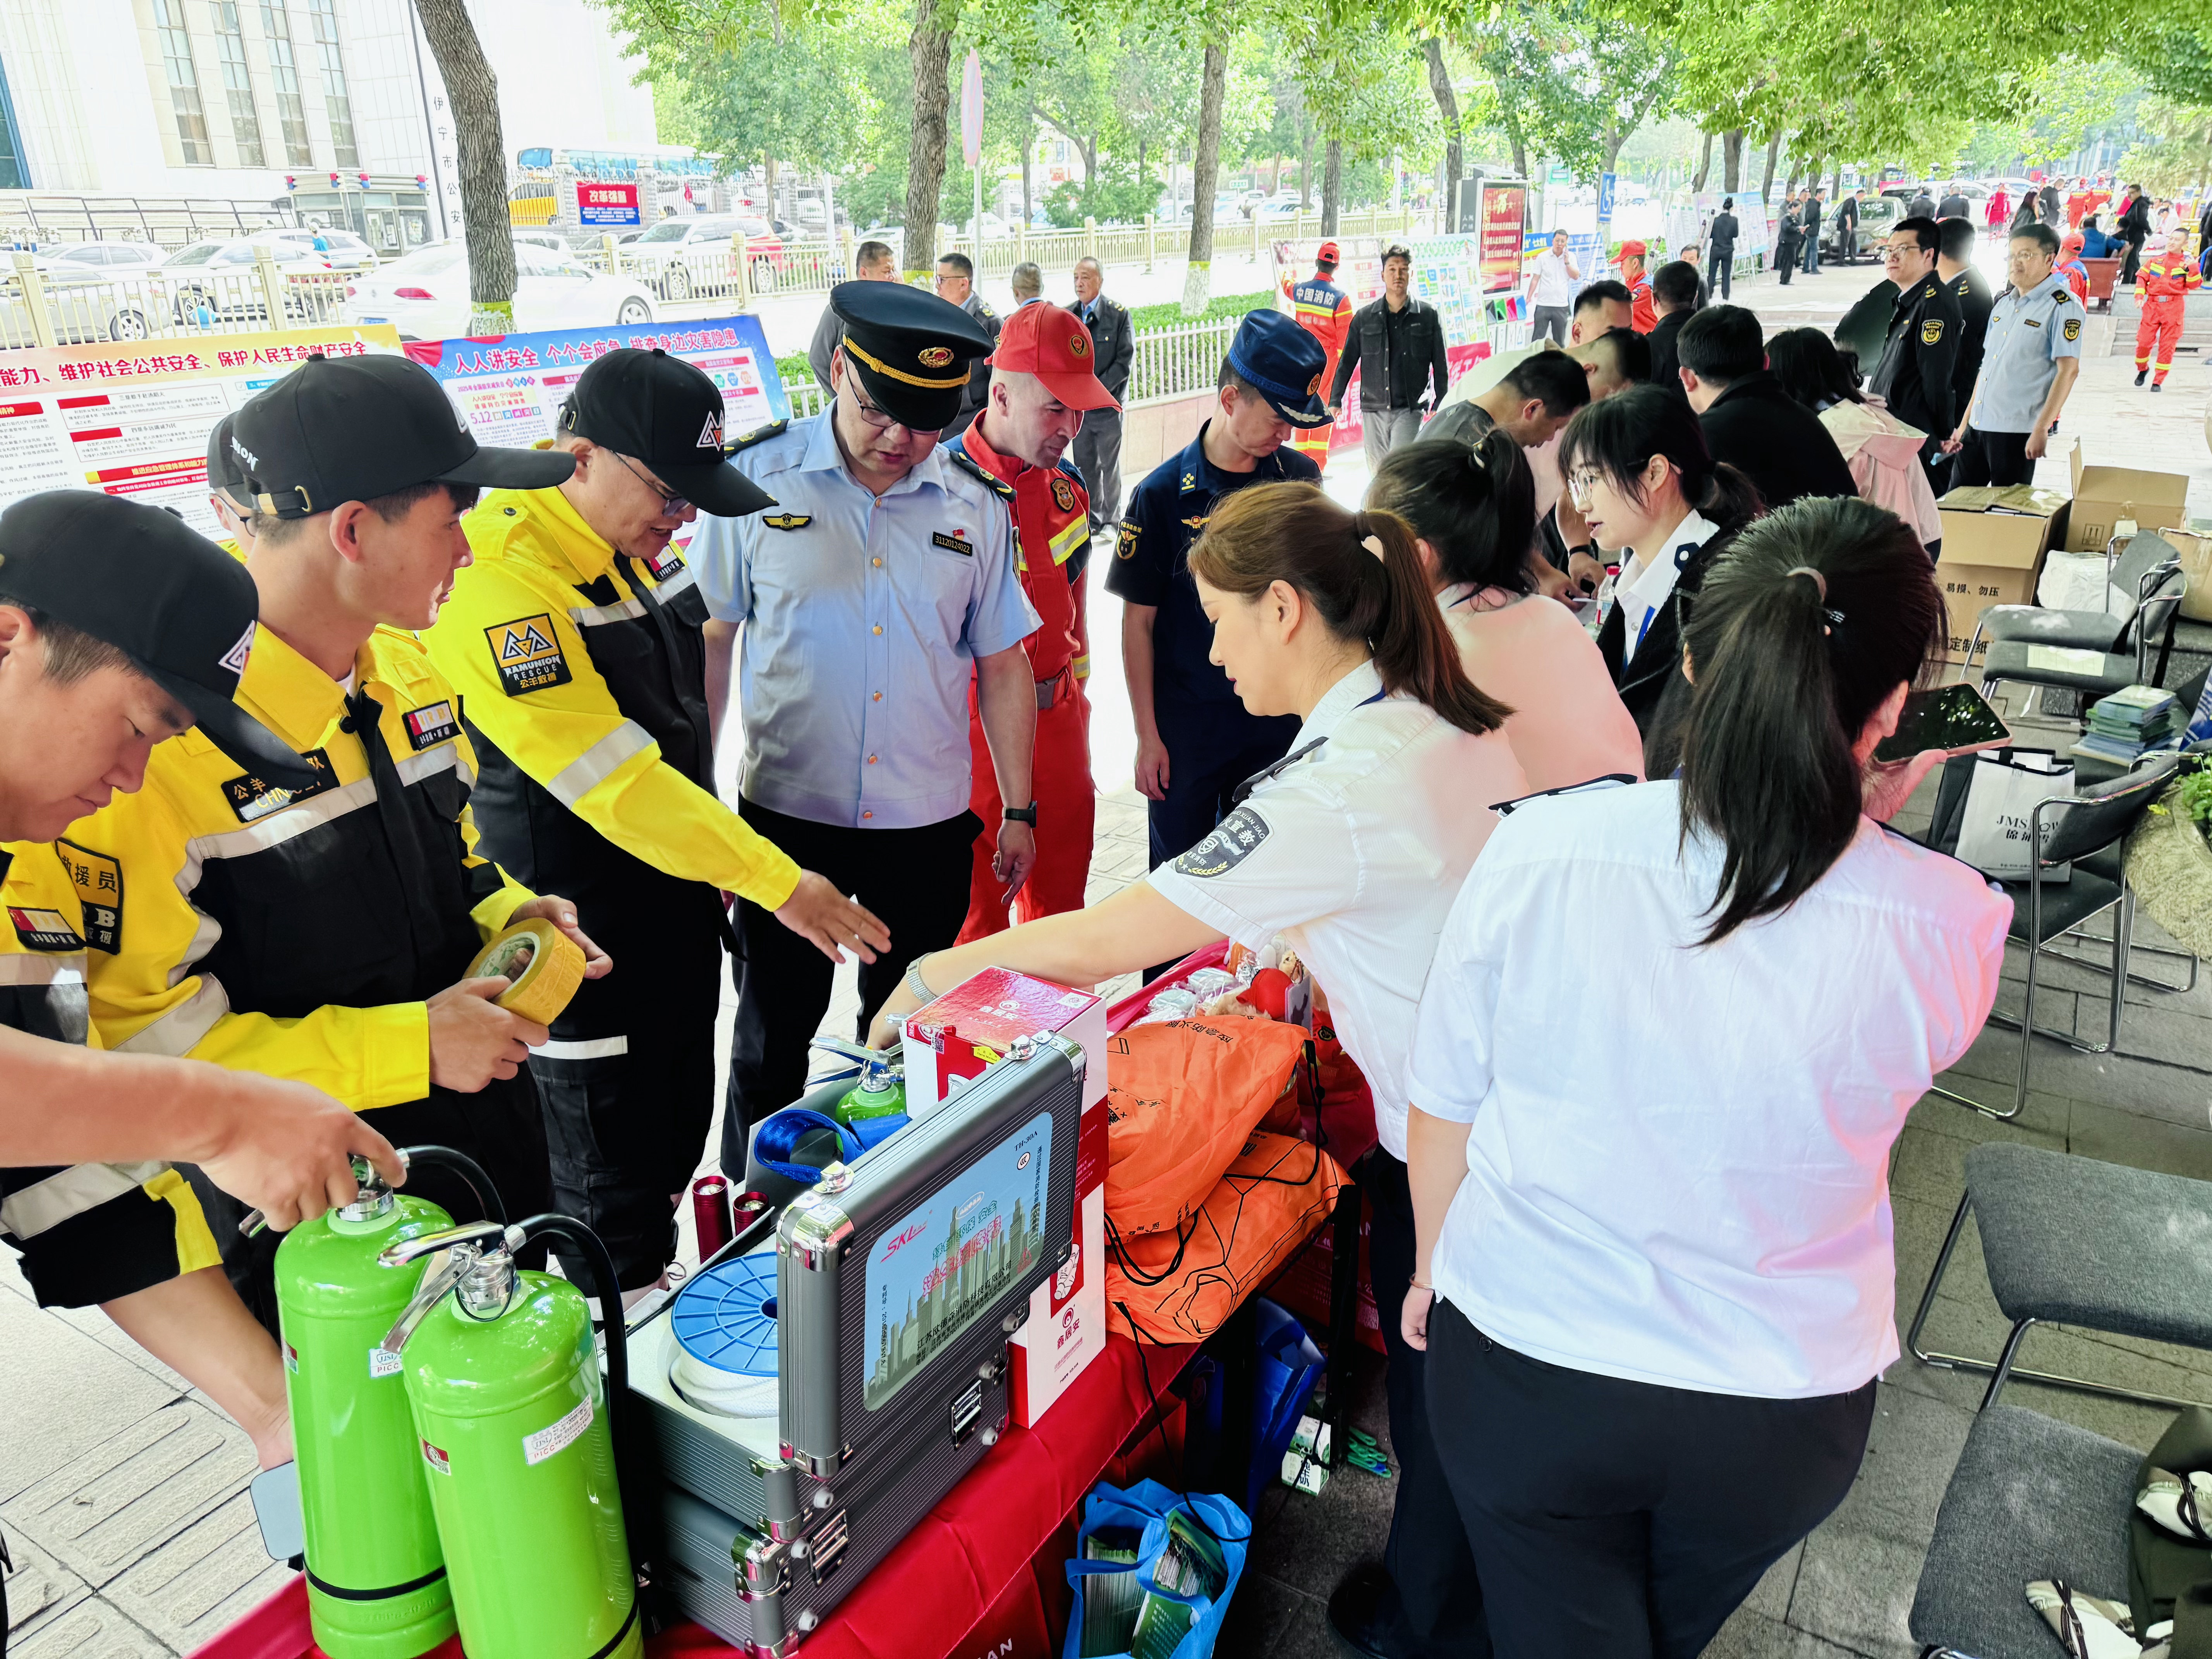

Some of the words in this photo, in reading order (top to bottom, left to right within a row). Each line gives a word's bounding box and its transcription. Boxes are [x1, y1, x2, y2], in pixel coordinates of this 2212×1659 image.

[434, 96, 463, 239] 伊宁市公安
[1296, 287, 1335, 306] 中国消防
[456, 347, 539, 373] 人人讲安全
[547, 340, 620, 364] 个个会应急
[630, 328, 738, 352] 排查身边灾害隐患
[0, 341, 366, 386] 能力、维护社会公共安全、保护人民生命财产安全
[470, 411, 493, 424] 5.12
[503, 655, 562, 678] RAMUNION
[513, 664, 557, 681] RESCUE
[520, 672, 557, 689] 公羊救援
[978, 1200, 998, 1224] 安全
[377, 1362, 399, 1373] PICC
[534, 1444, 555, 1459] PICC
